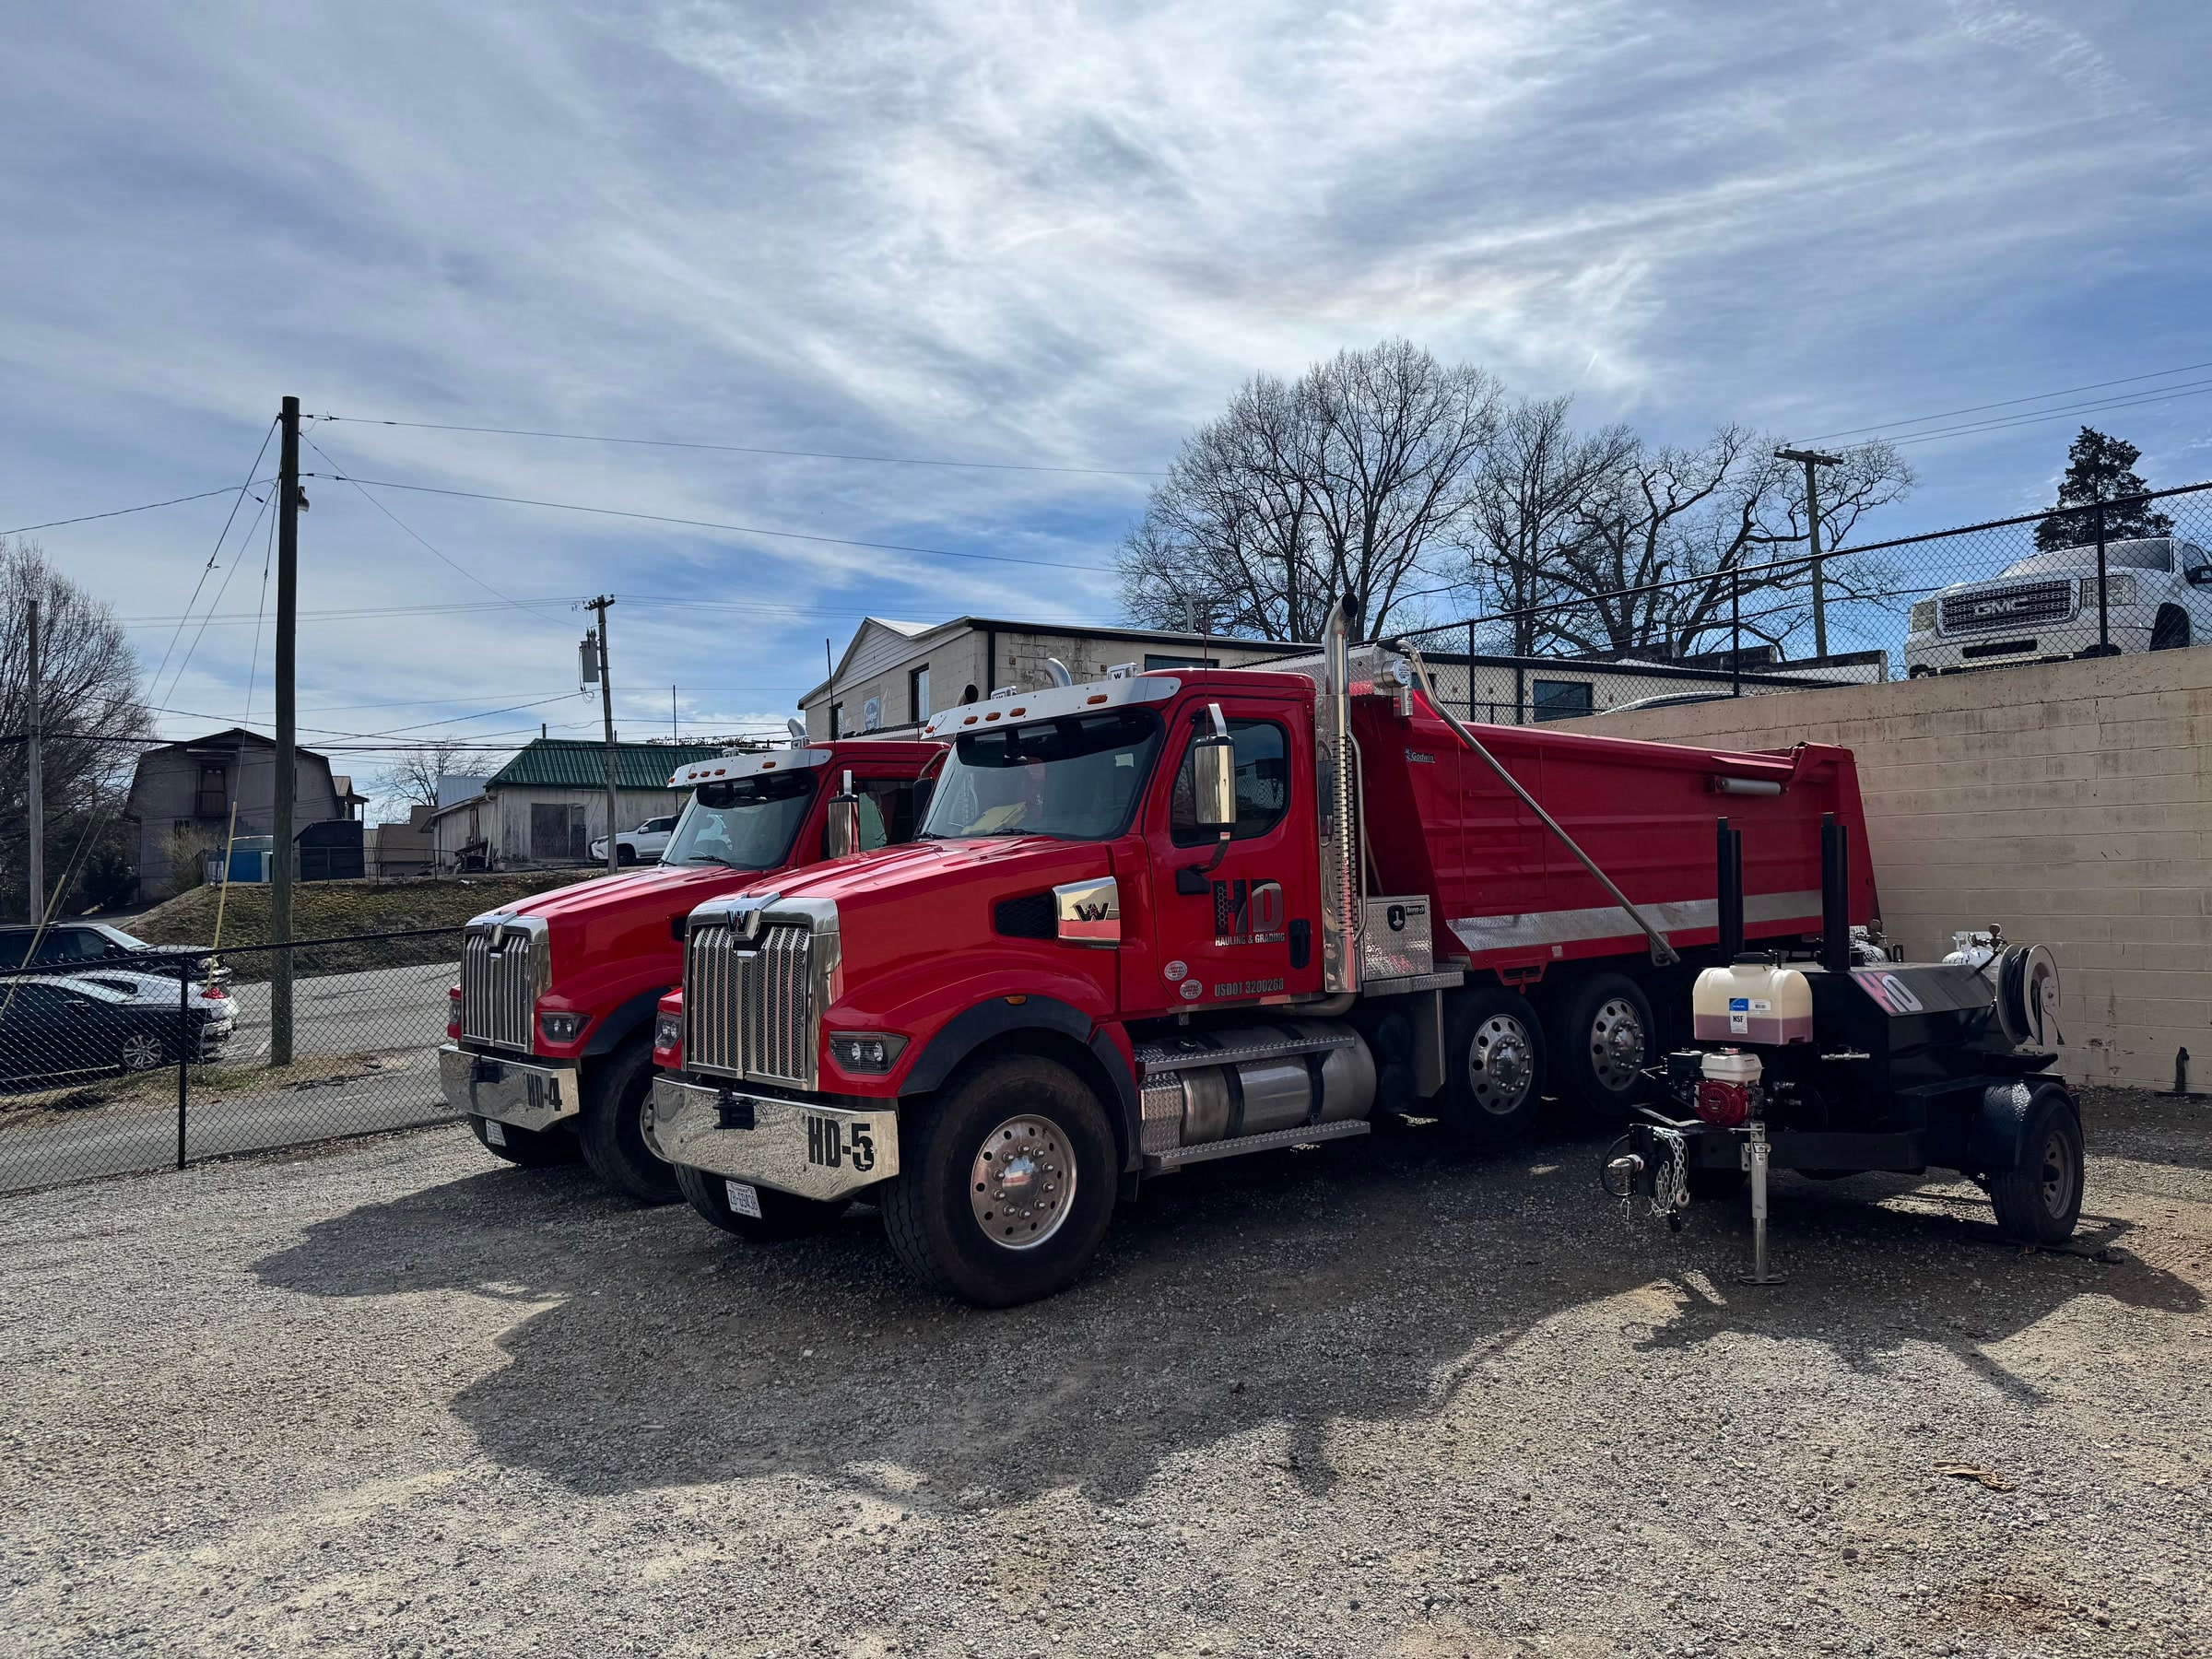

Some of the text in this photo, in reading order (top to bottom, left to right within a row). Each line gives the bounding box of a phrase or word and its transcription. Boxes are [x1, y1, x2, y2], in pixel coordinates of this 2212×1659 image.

[1974, 598, 2029, 616] GMC
[1213, 878, 1284, 935] HD
[1215, 932, 1285, 947] HAULING & GRADING
[1215, 982, 1243, 997] USDOT
[1733, 1015, 1744, 1023] NSF
[526, 1073, 563, 1112] HD-4
[808, 1116, 875, 1171] HD-5
